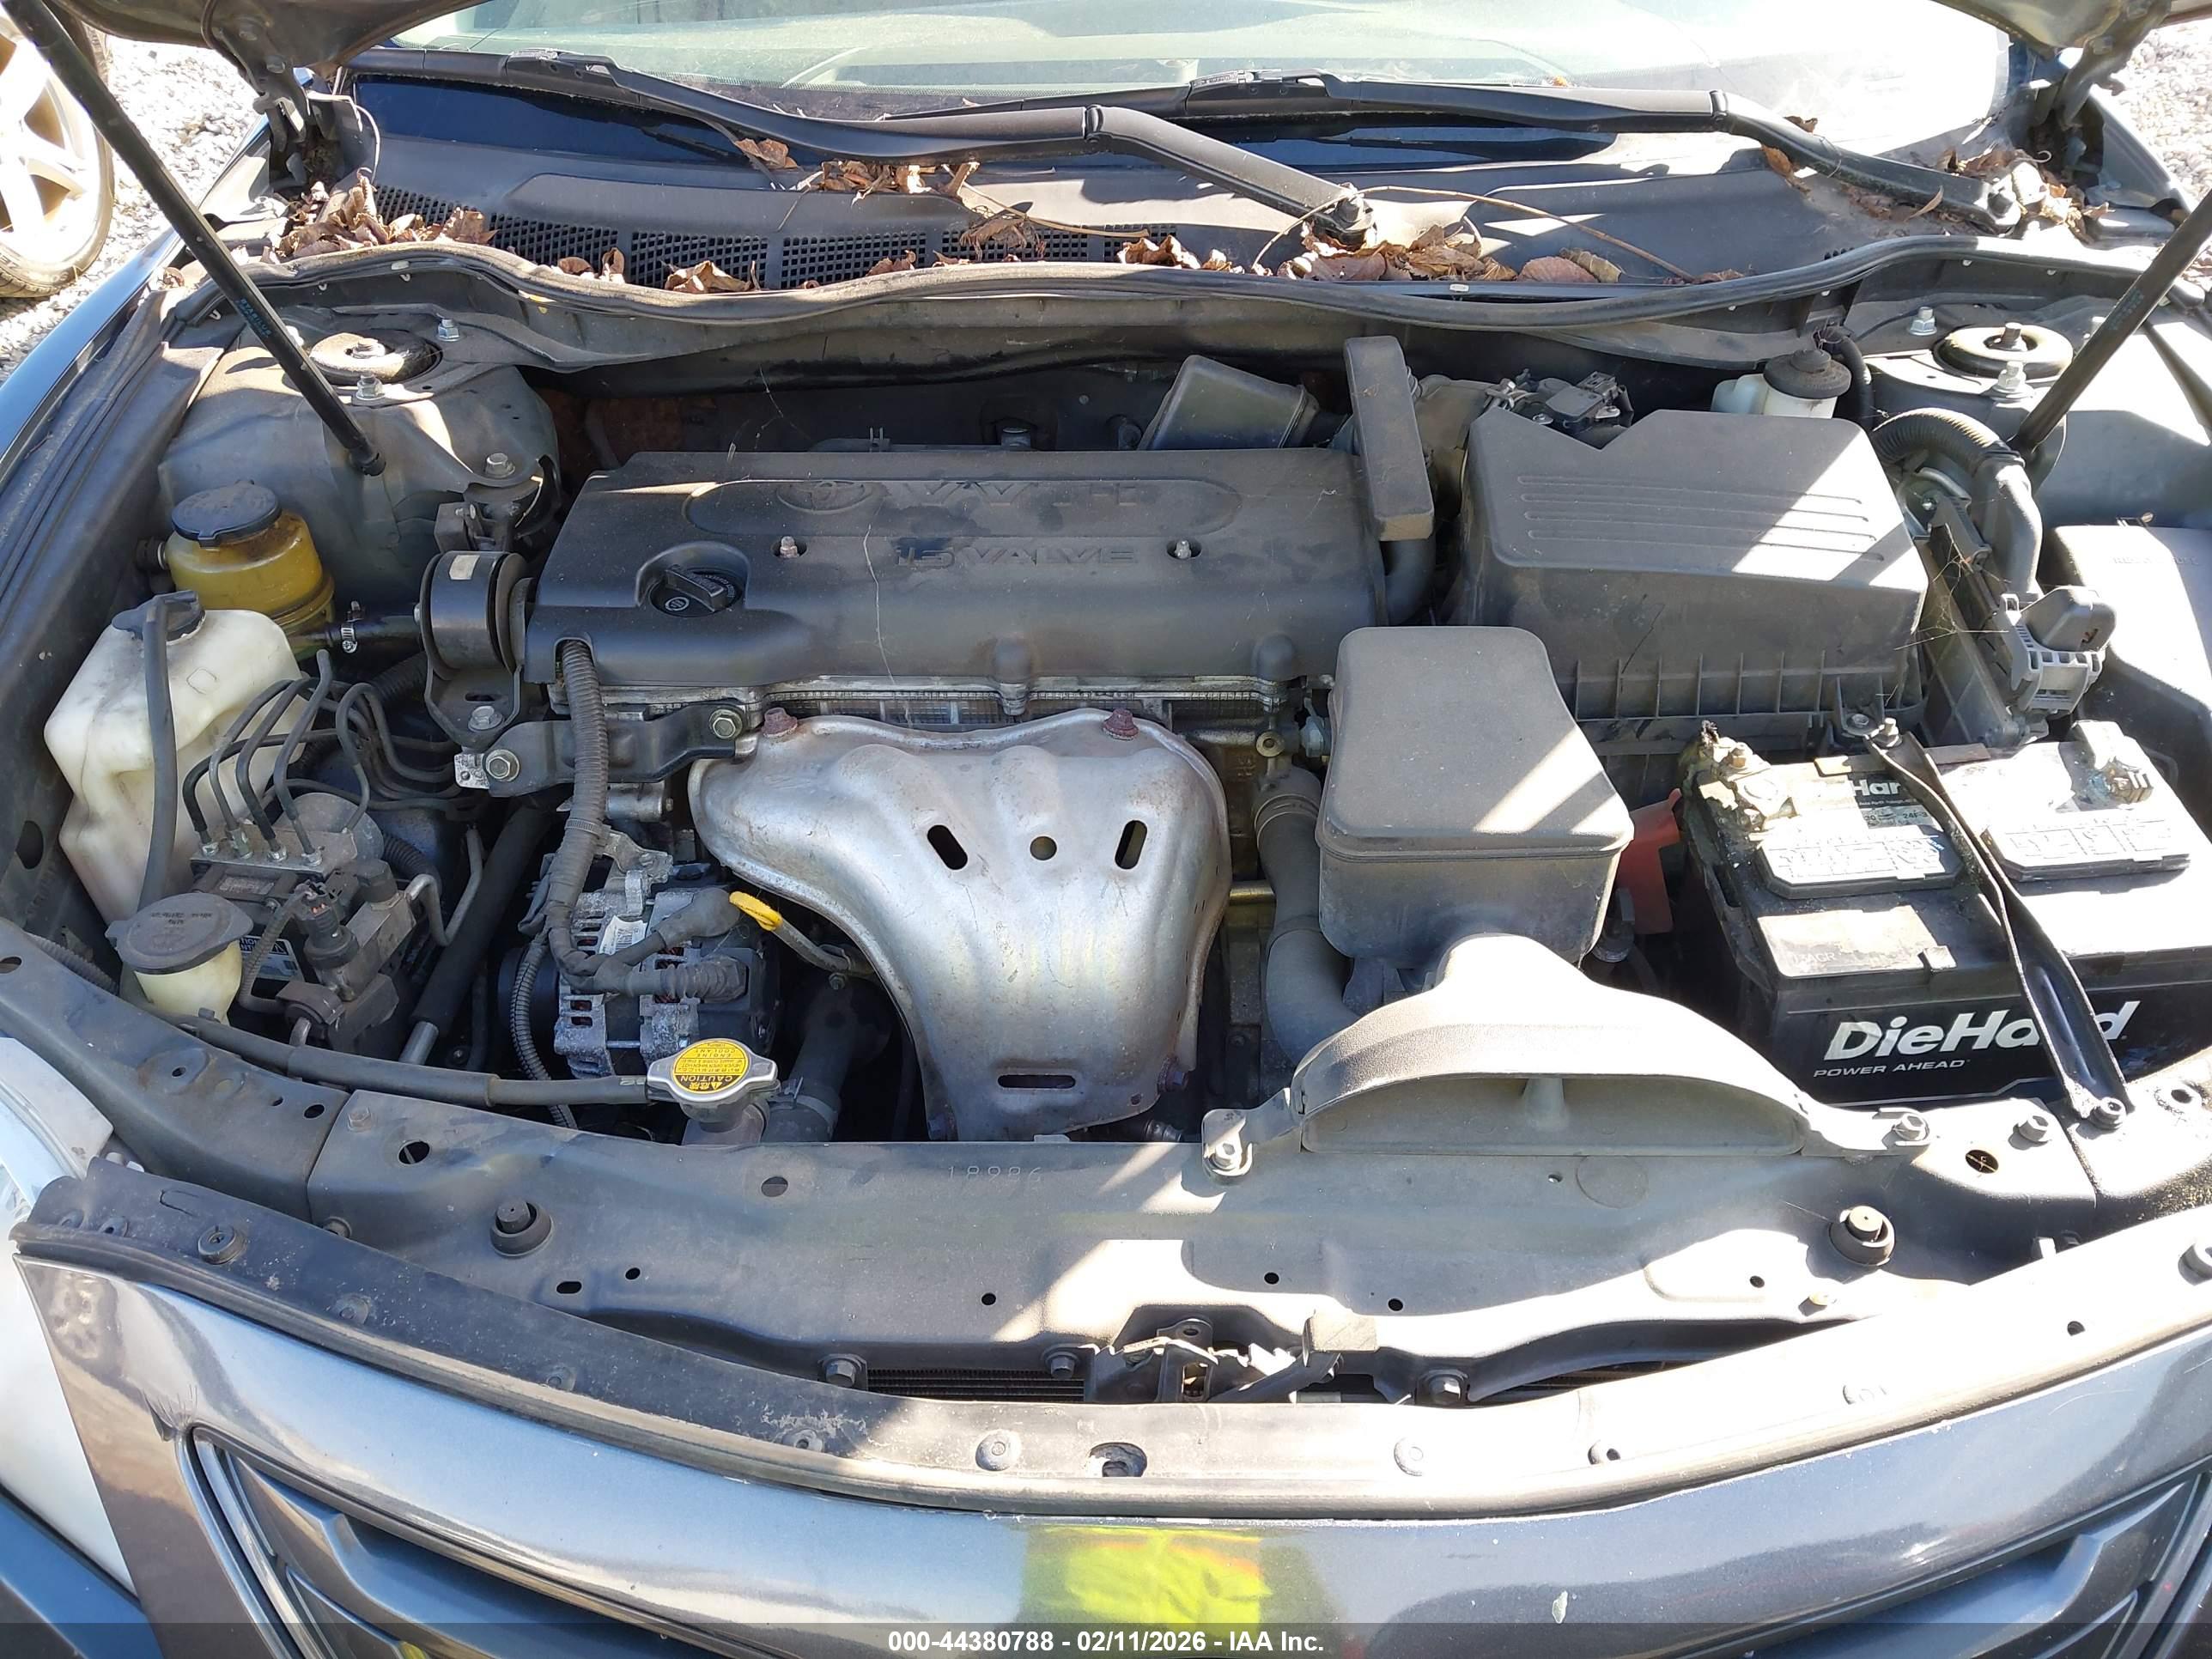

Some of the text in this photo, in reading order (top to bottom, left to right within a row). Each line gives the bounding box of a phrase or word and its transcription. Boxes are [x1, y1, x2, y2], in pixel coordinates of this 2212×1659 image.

[965, 547, 1139, 565] VALVE
[1824, 1000, 2141, 1061] DieHad
[1813, 1059, 1966, 1078] POWER AHEAD
